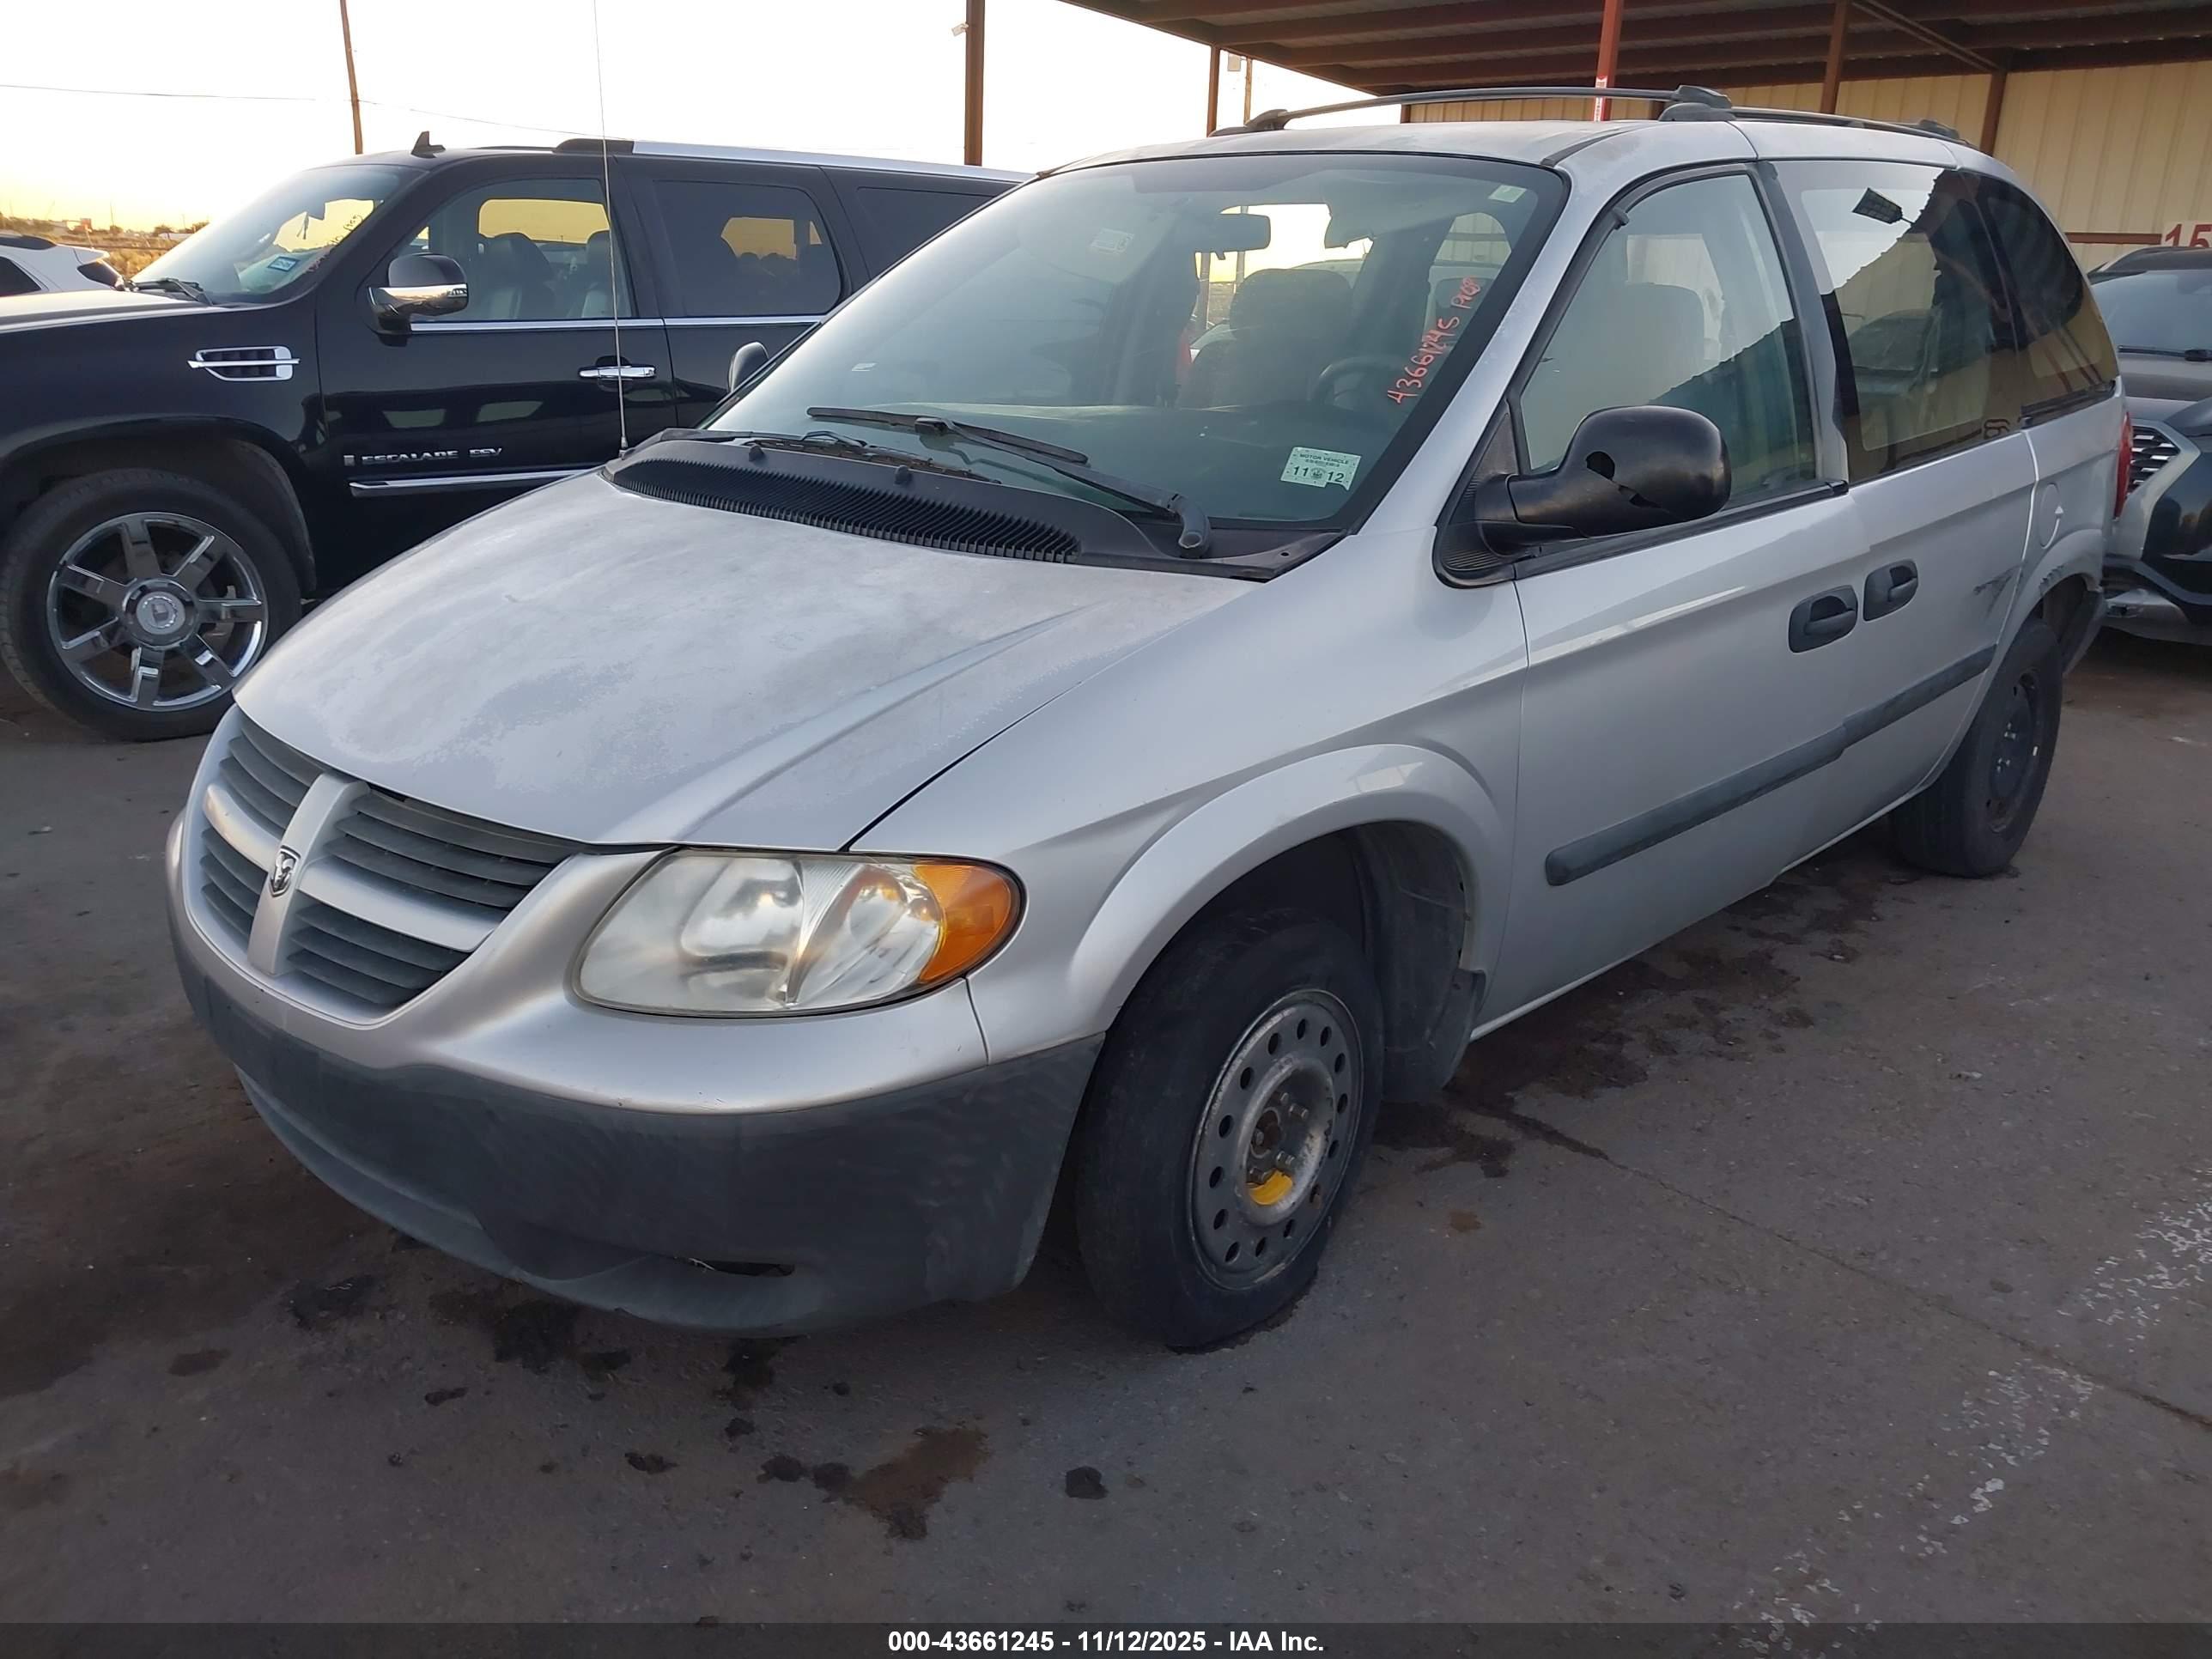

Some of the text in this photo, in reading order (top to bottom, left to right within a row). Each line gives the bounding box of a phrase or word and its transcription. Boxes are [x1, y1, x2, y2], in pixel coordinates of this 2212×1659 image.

[362, 450, 459, 465] ESCALADE
[1293, 465, 1345, 483] 11 12
